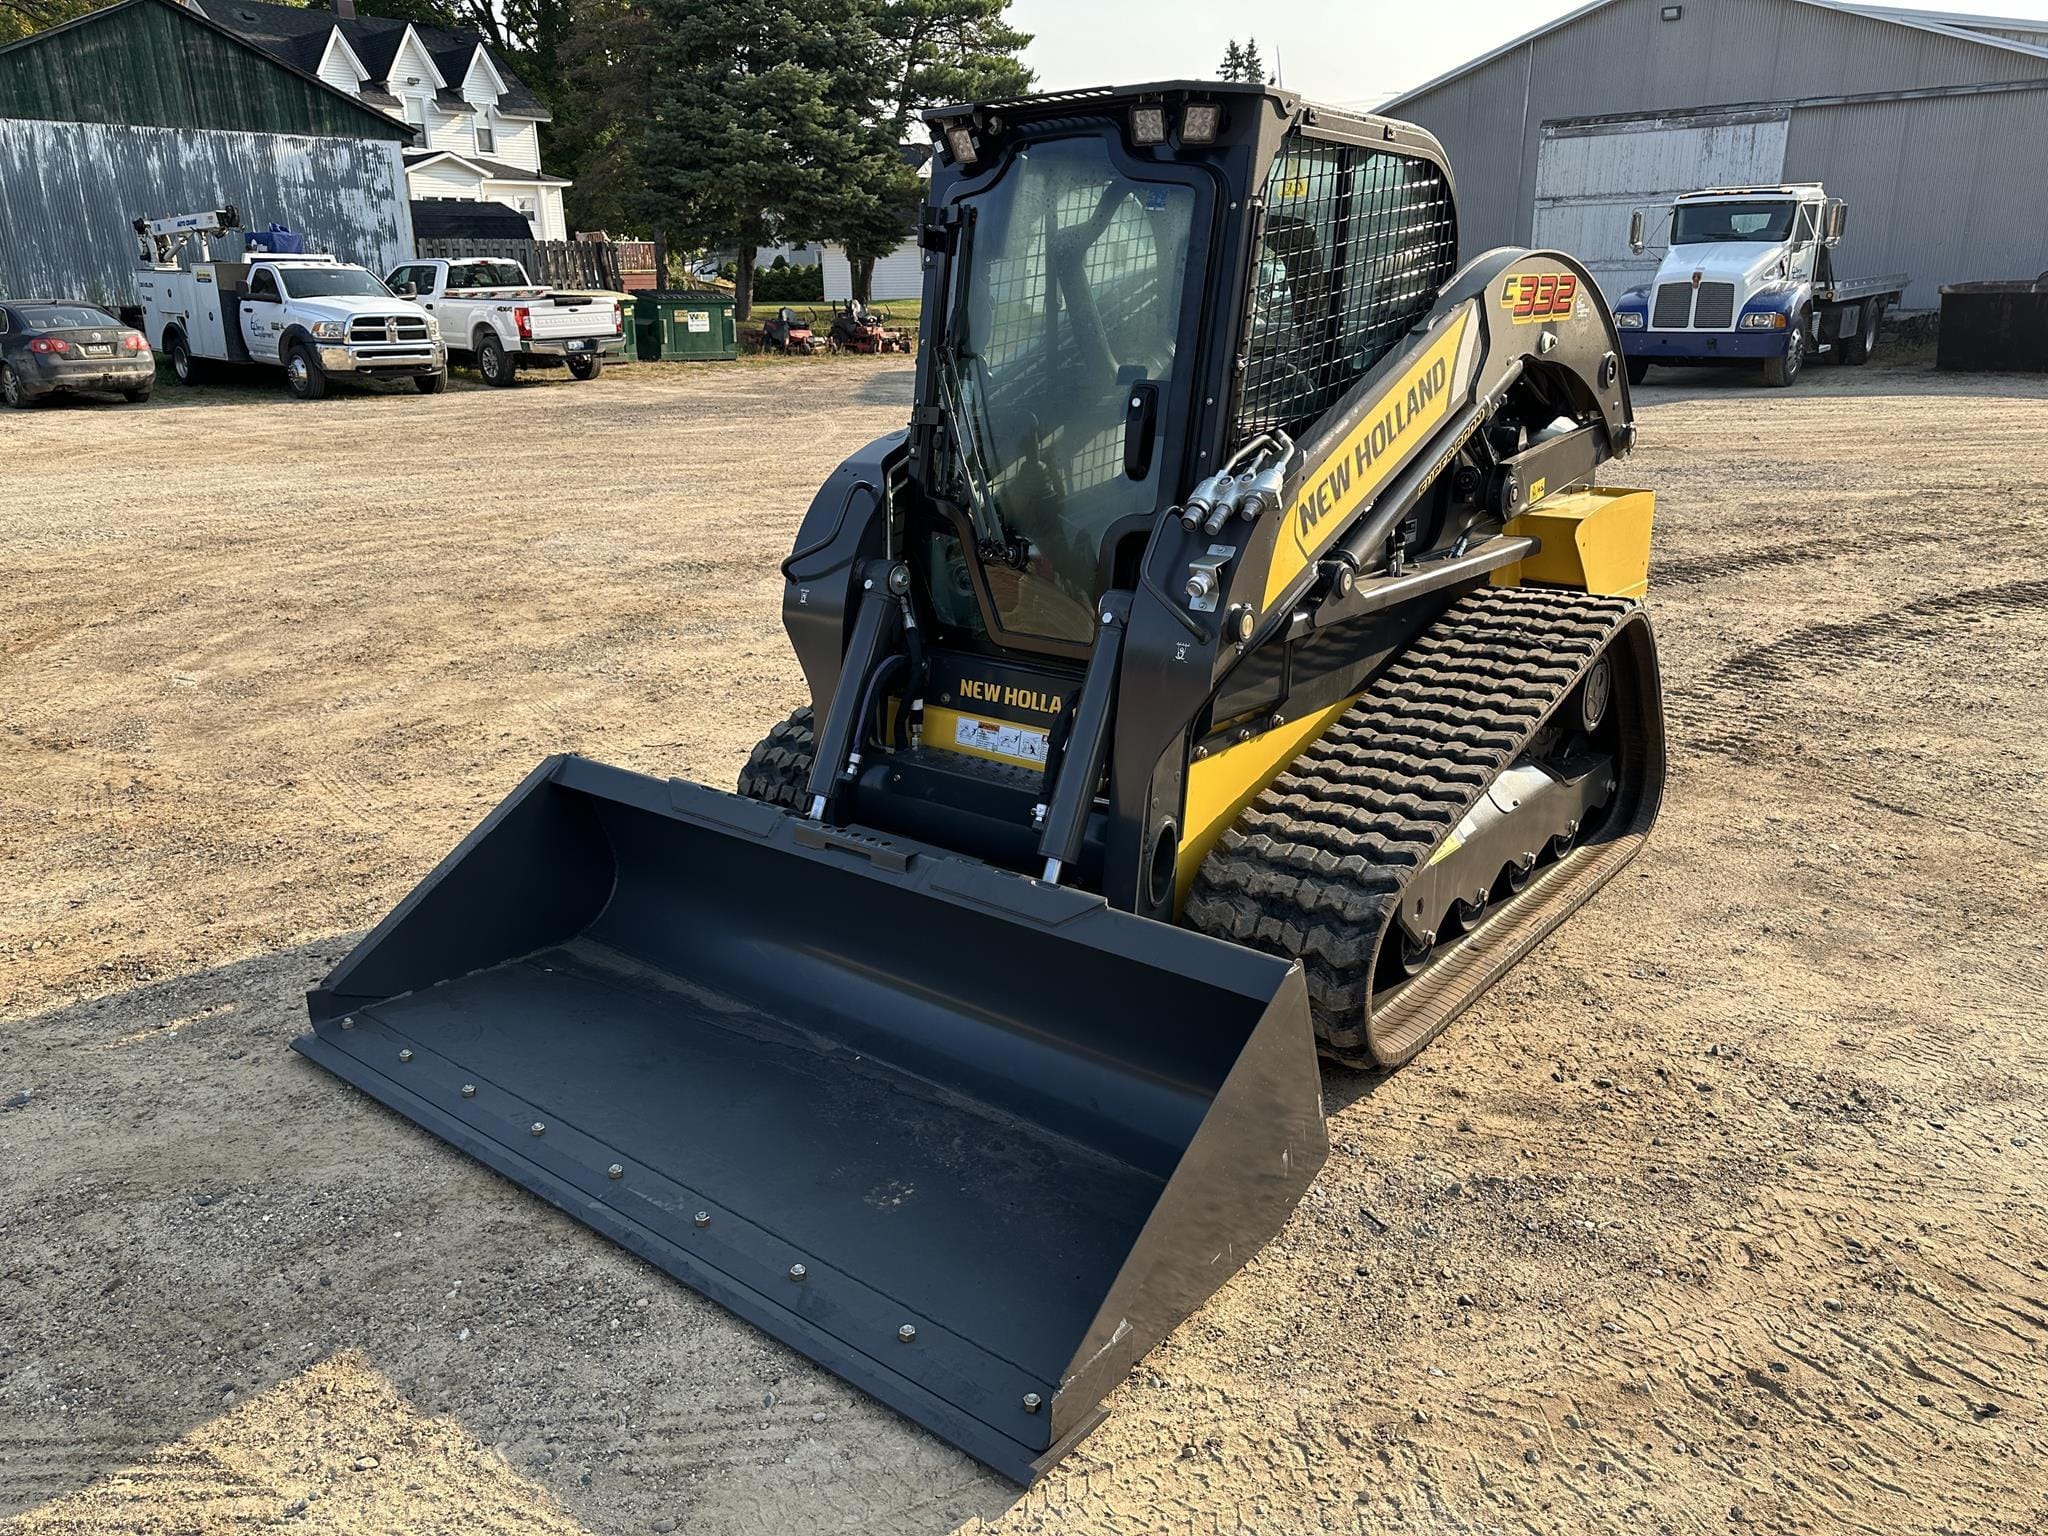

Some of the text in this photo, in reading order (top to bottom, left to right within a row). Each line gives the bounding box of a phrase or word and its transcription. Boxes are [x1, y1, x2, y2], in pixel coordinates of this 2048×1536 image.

[1501, 275, 1577, 318] C332
[1299, 357, 1446, 537] NEW HOLLAND
[960, 679, 1062, 714] NEW HOLLA
